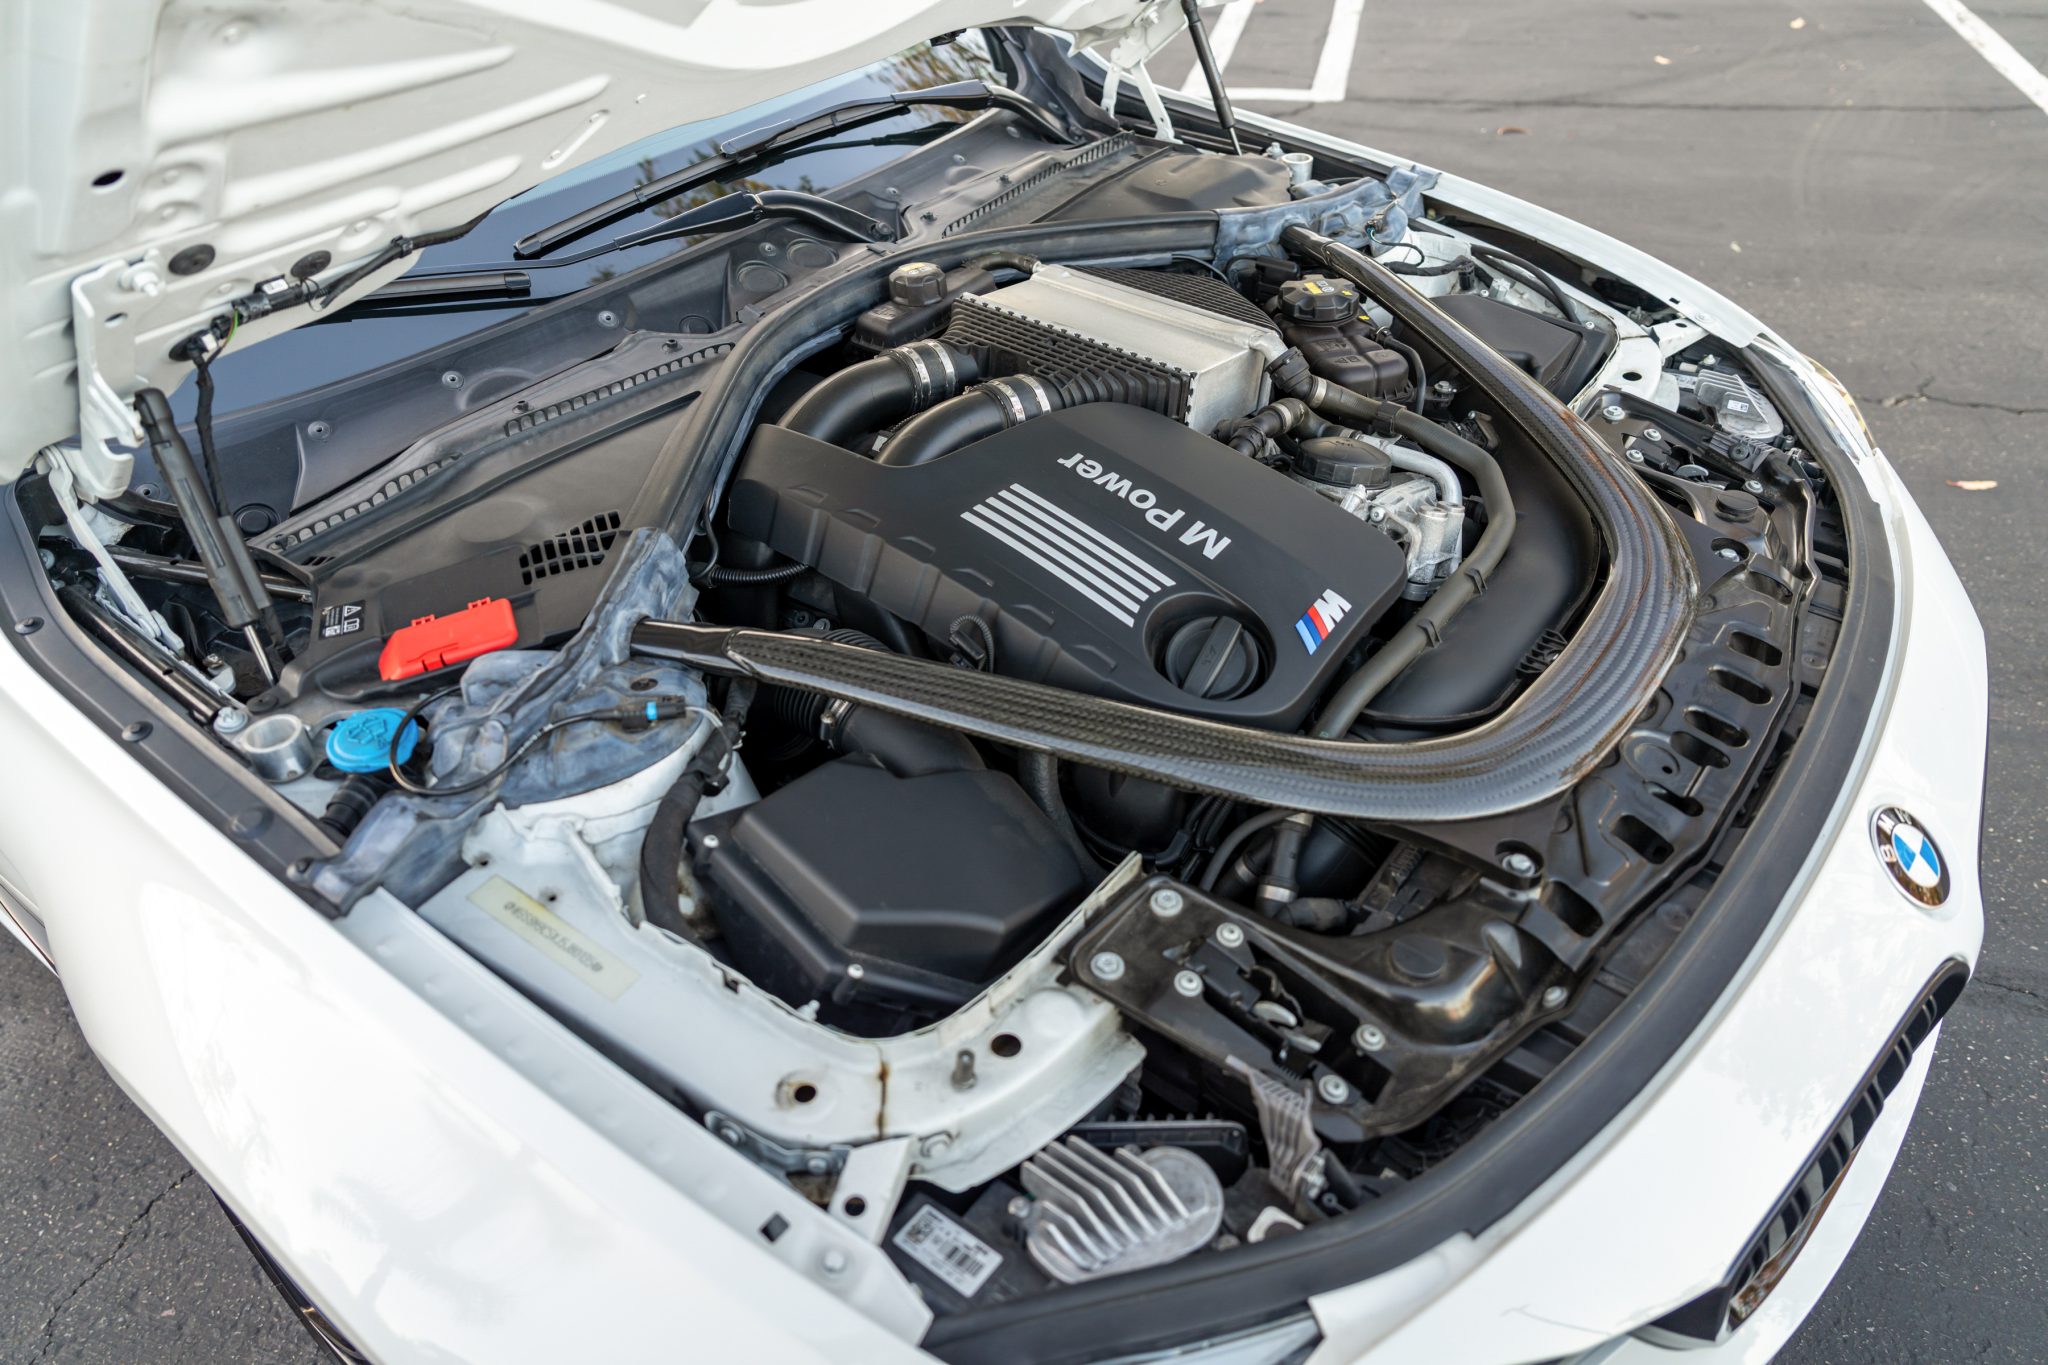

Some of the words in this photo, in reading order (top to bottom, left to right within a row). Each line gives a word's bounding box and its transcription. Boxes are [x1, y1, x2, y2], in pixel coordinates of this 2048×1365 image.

[1056, 452, 1186, 533] Power
[1178, 520, 1232, 561] M
[1877, 807, 1913, 863] BMW
